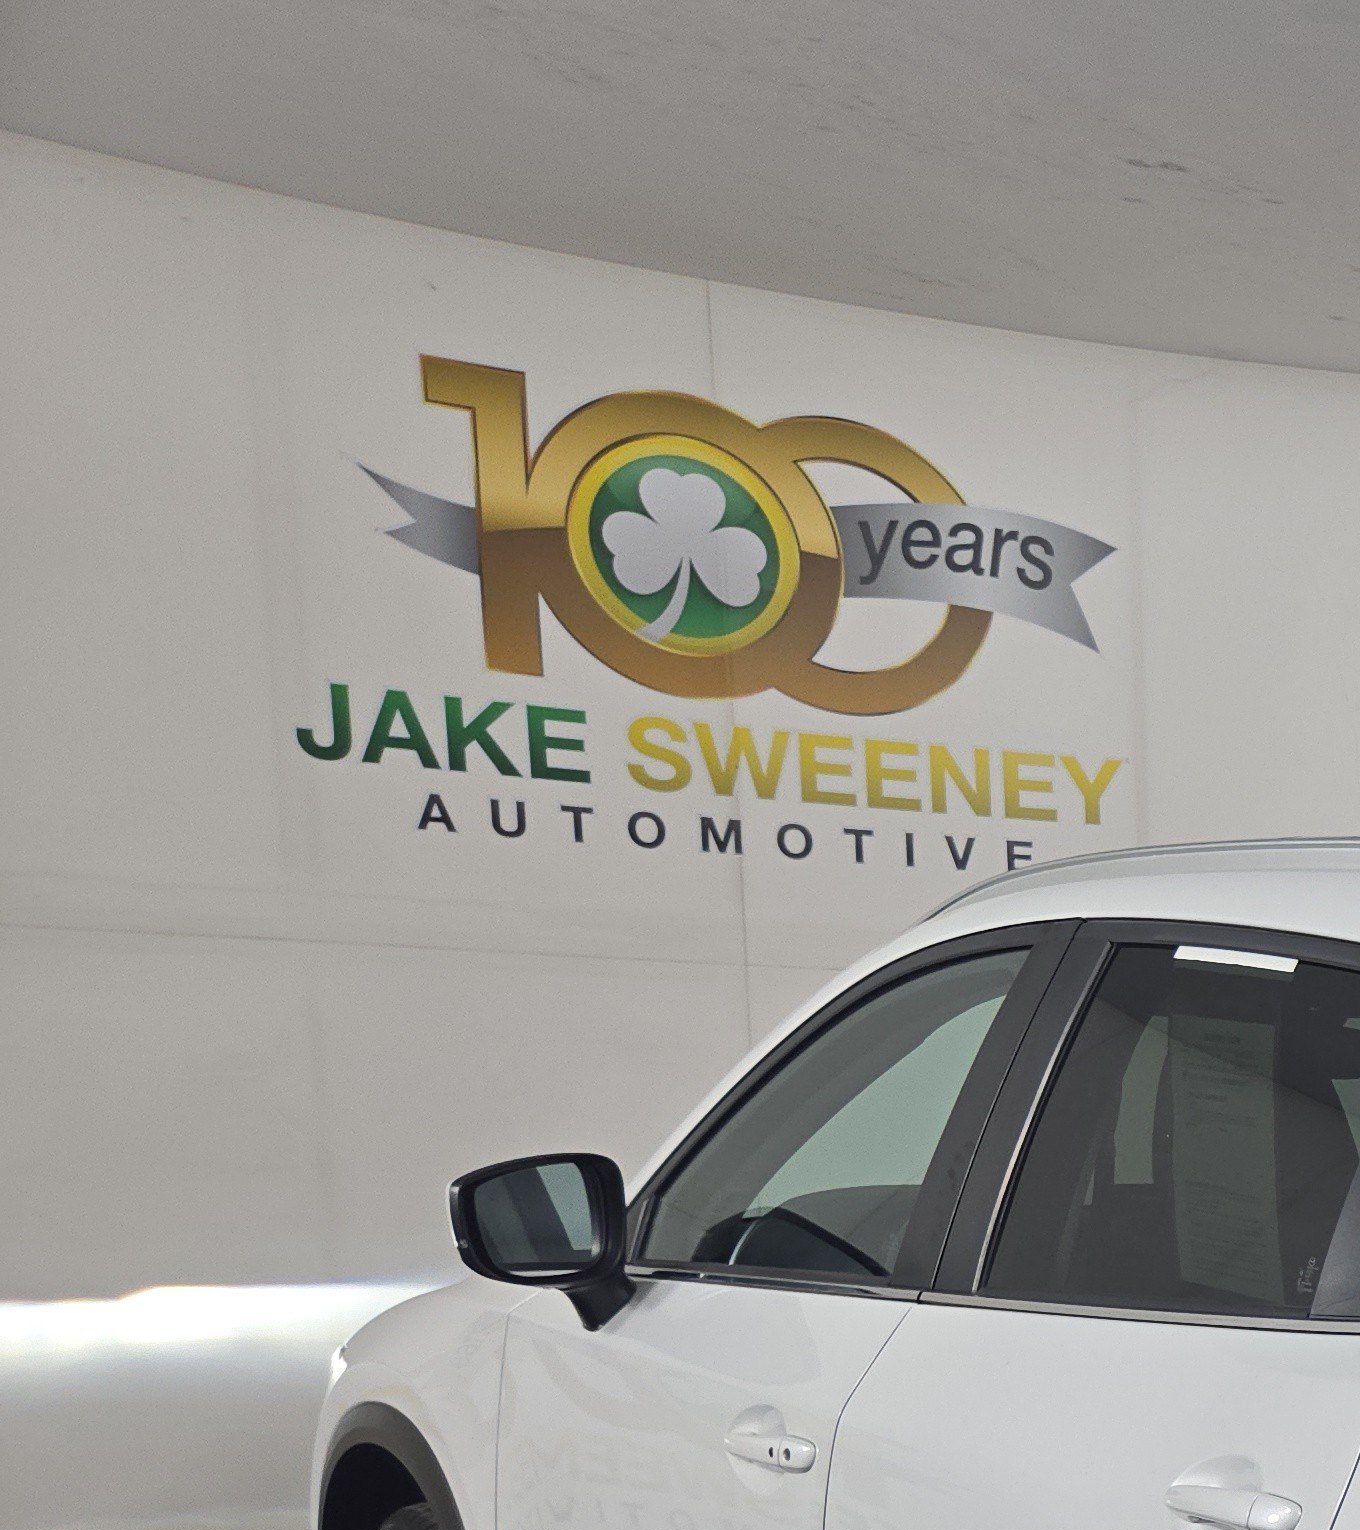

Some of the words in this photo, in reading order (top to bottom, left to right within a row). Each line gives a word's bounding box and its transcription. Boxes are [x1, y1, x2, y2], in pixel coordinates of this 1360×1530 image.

[857, 514, 1056, 590] years
[297, 684, 593, 784] JAKE
[627, 716, 1122, 825] SWEENEY
[418, 793, 1033, 872] AUTOMOTIVE
